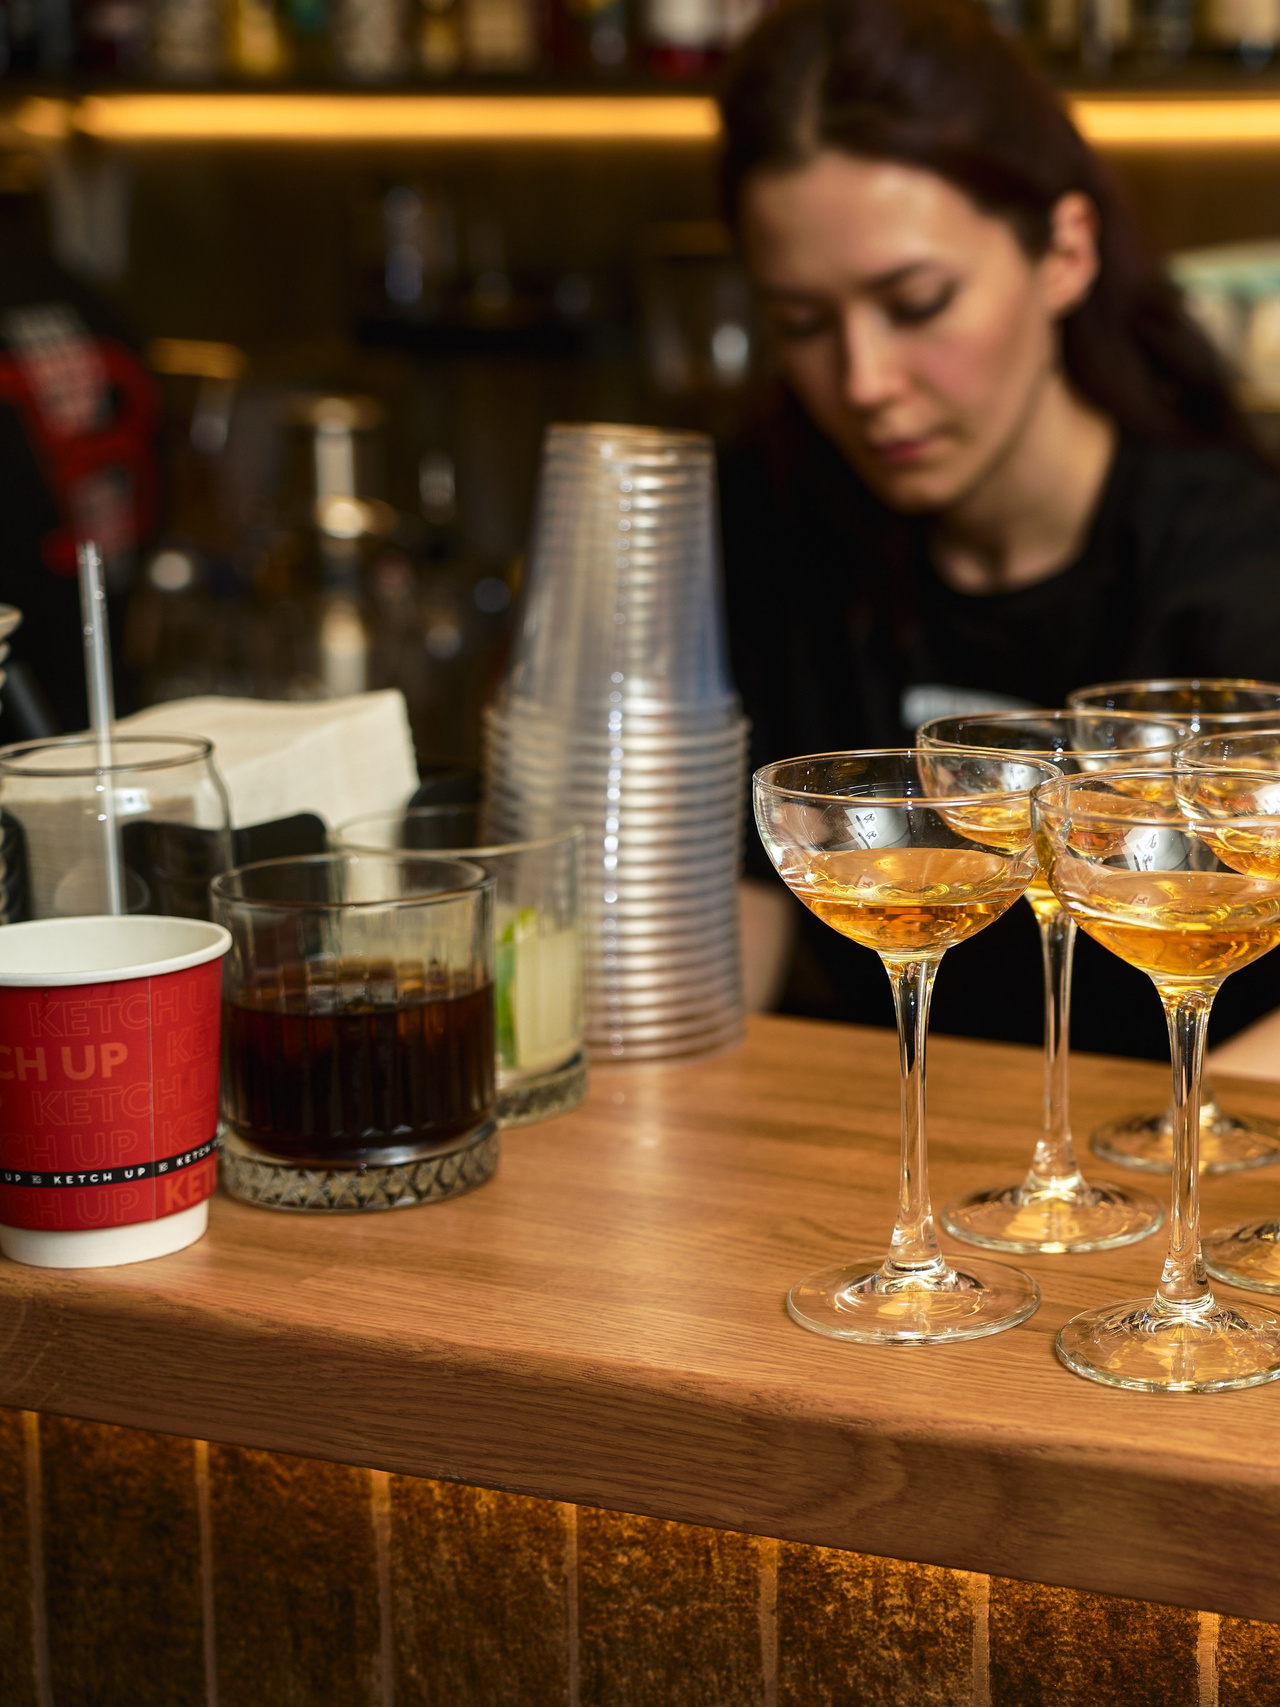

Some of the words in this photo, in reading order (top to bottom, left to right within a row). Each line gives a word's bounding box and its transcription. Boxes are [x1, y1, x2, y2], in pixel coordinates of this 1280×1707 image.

[28, 986, 180, 1038] KETCH
[60, 1042, 129, 1081] UP
[31, 1073, 182, 1126] KETCH
[4, 1171, 22, 1183] UP
[53, 1172, 113, 1185] KETCH
[124, 1167, 146, 1179] UP
[176, 1144, 211, 1168] KETCH
[71, 1129, 138, 1169] UP
[75, 1187, 140, 1225] UP
